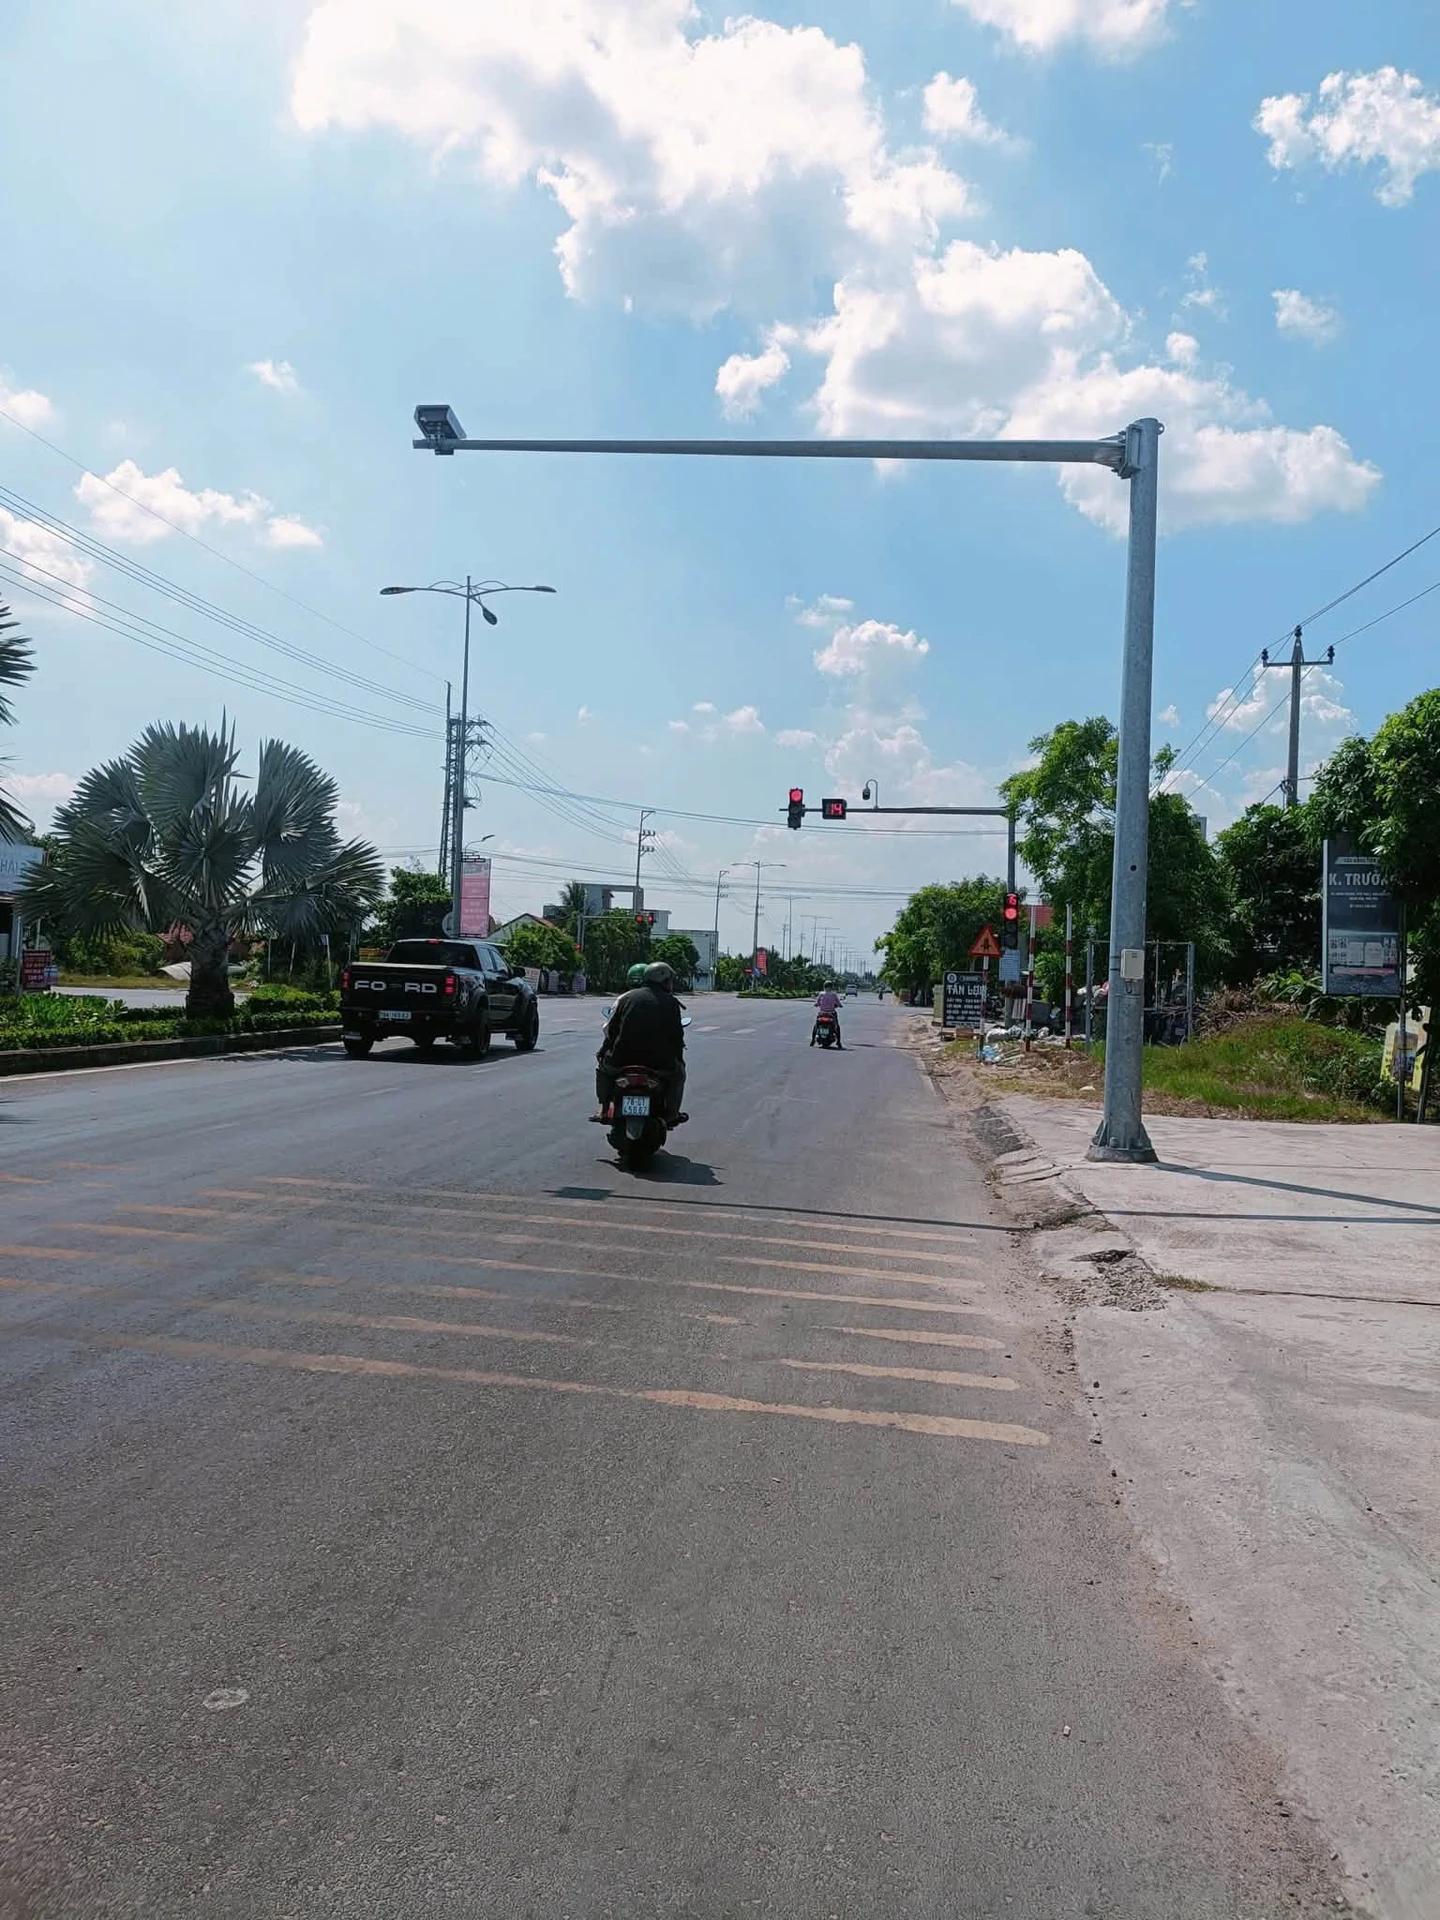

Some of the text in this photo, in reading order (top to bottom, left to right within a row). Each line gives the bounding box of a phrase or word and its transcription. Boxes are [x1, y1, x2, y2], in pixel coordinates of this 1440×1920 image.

[831, 803, 842, 815] 14
[1329, 870, 1394, 886] K. TRƯỞ
